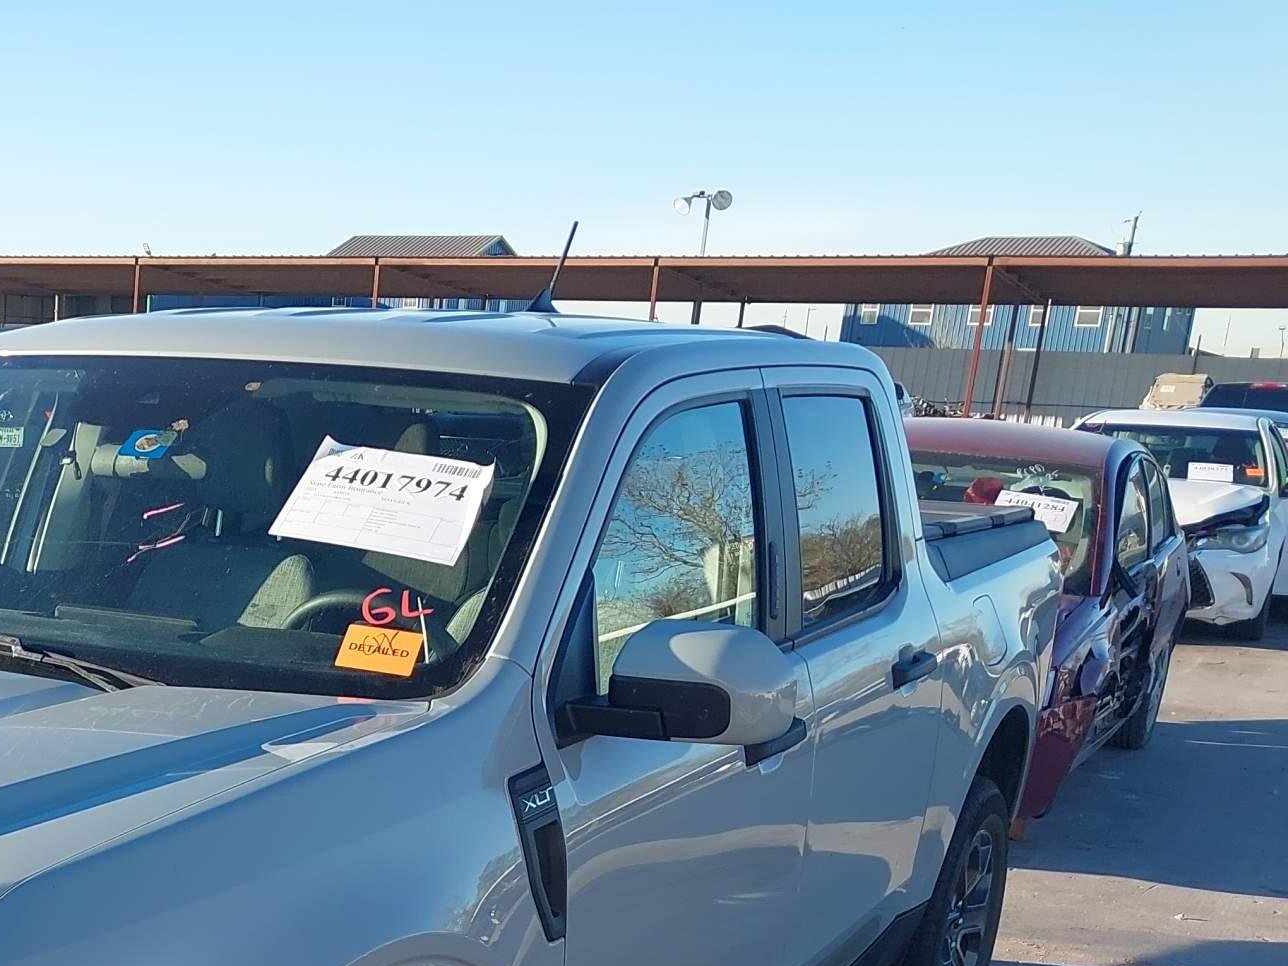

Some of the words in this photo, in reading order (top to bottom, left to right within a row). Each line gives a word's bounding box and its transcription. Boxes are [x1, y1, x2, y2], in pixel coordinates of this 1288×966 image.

[325, 465, 469, 502] 44017974
[348, 642, 410, 658] DETAILED
[522, 786, 553, 813] XLT
